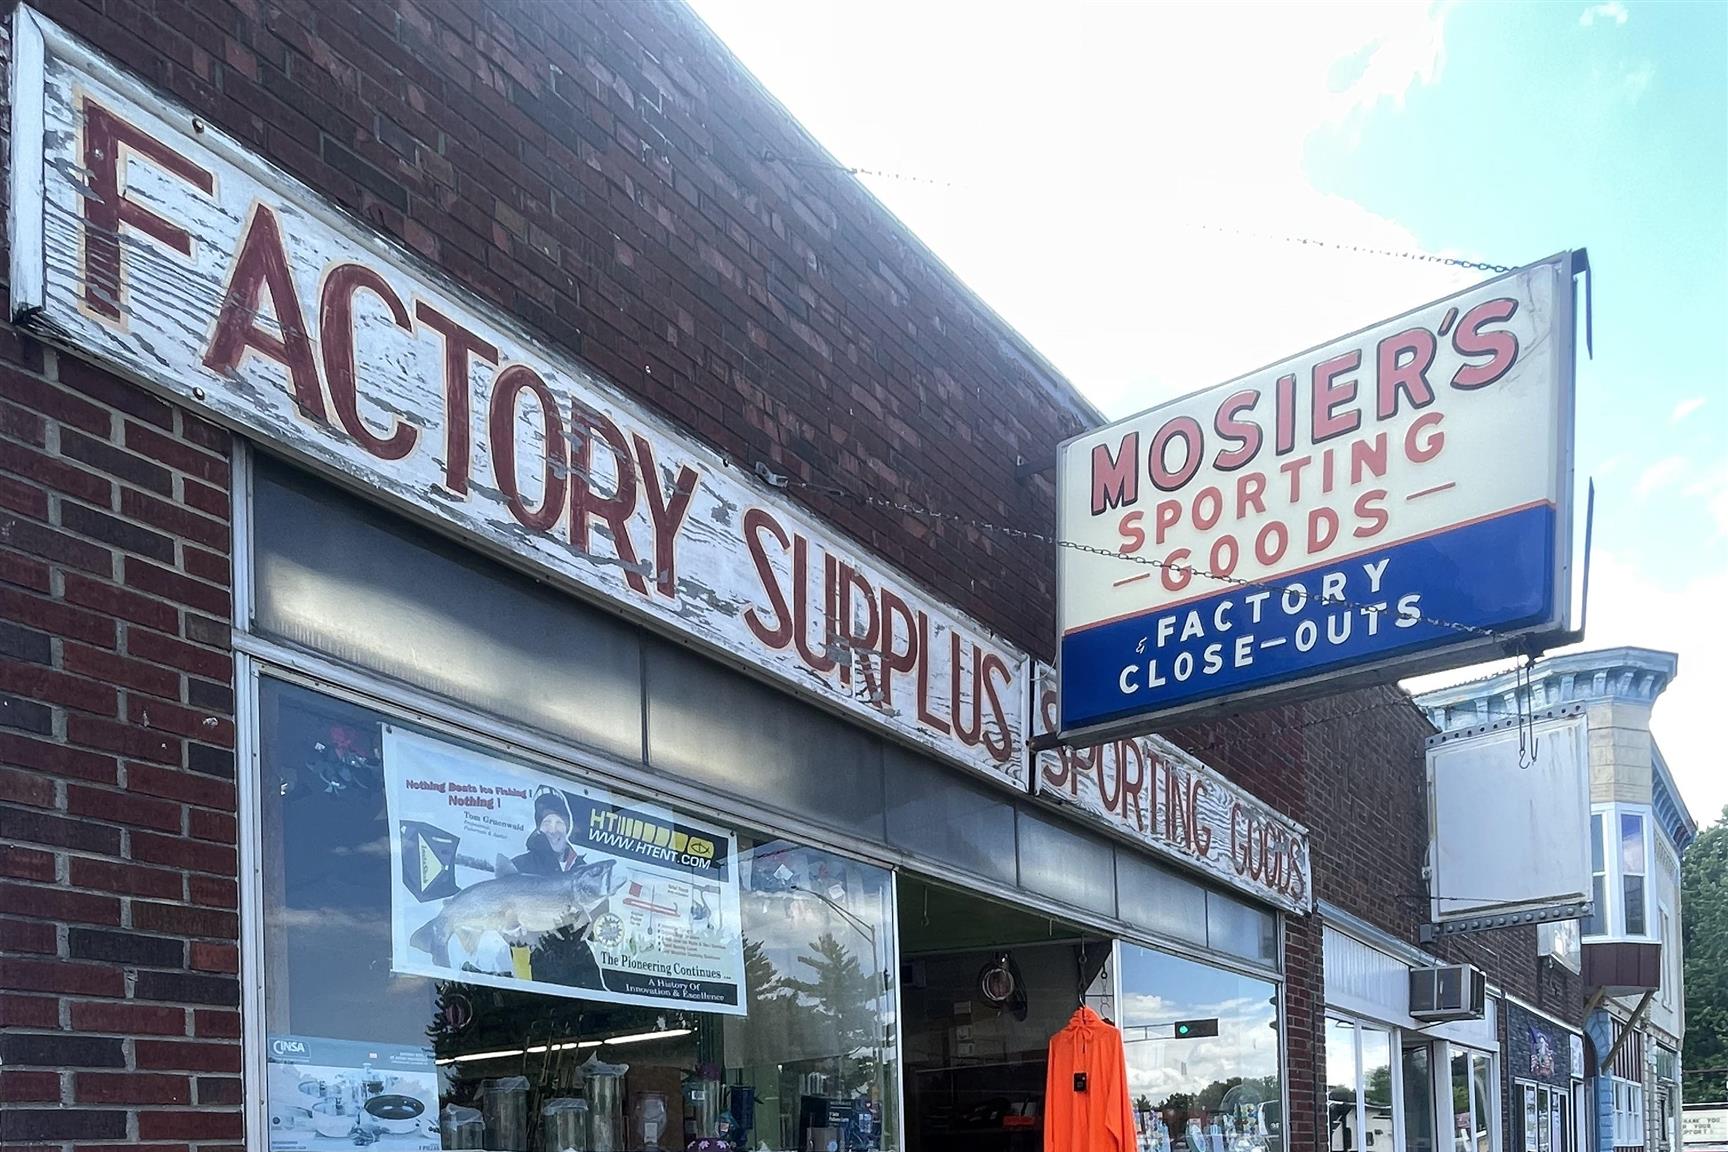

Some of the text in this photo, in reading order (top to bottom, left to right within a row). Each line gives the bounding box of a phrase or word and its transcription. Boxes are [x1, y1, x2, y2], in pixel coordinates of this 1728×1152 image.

[1090, 296, 1520, 517] MOSIER'S
[80, 92, 698, 602] FACTORY
[742, 504, 1012, 764] SURPLUS
[1230, 802, 1305, 899] GOODS
[1117, 411, 1446, 556] SPORTING
[1159, 488, 1390, 592] GOODS
[1156, 558, 1392, 649] FACTORY
[1118, 593, 1424, 696] CLOSE-OUTS
[405, 779, 447, 794] Nothing
[496, 786, 528, 800] Fishing
[448, 794, 495, 810] Nothing
[463, 810, 481, 821] Tom
[590, 808, 619, 832] HT
[588, 828, 711, 870] WWW.HTENT.COM
[600, 951, 619, 967] The
[621, 954, 672, 976] Pioneering
[673, 962, 722, 980] Continues
[625, 983, 671, 996] Innovation
[682, 990, 725, 1001] Excellence
[648, 978, 701, 992] A History Of
[273, 1040, 305, 1055] CINSA
